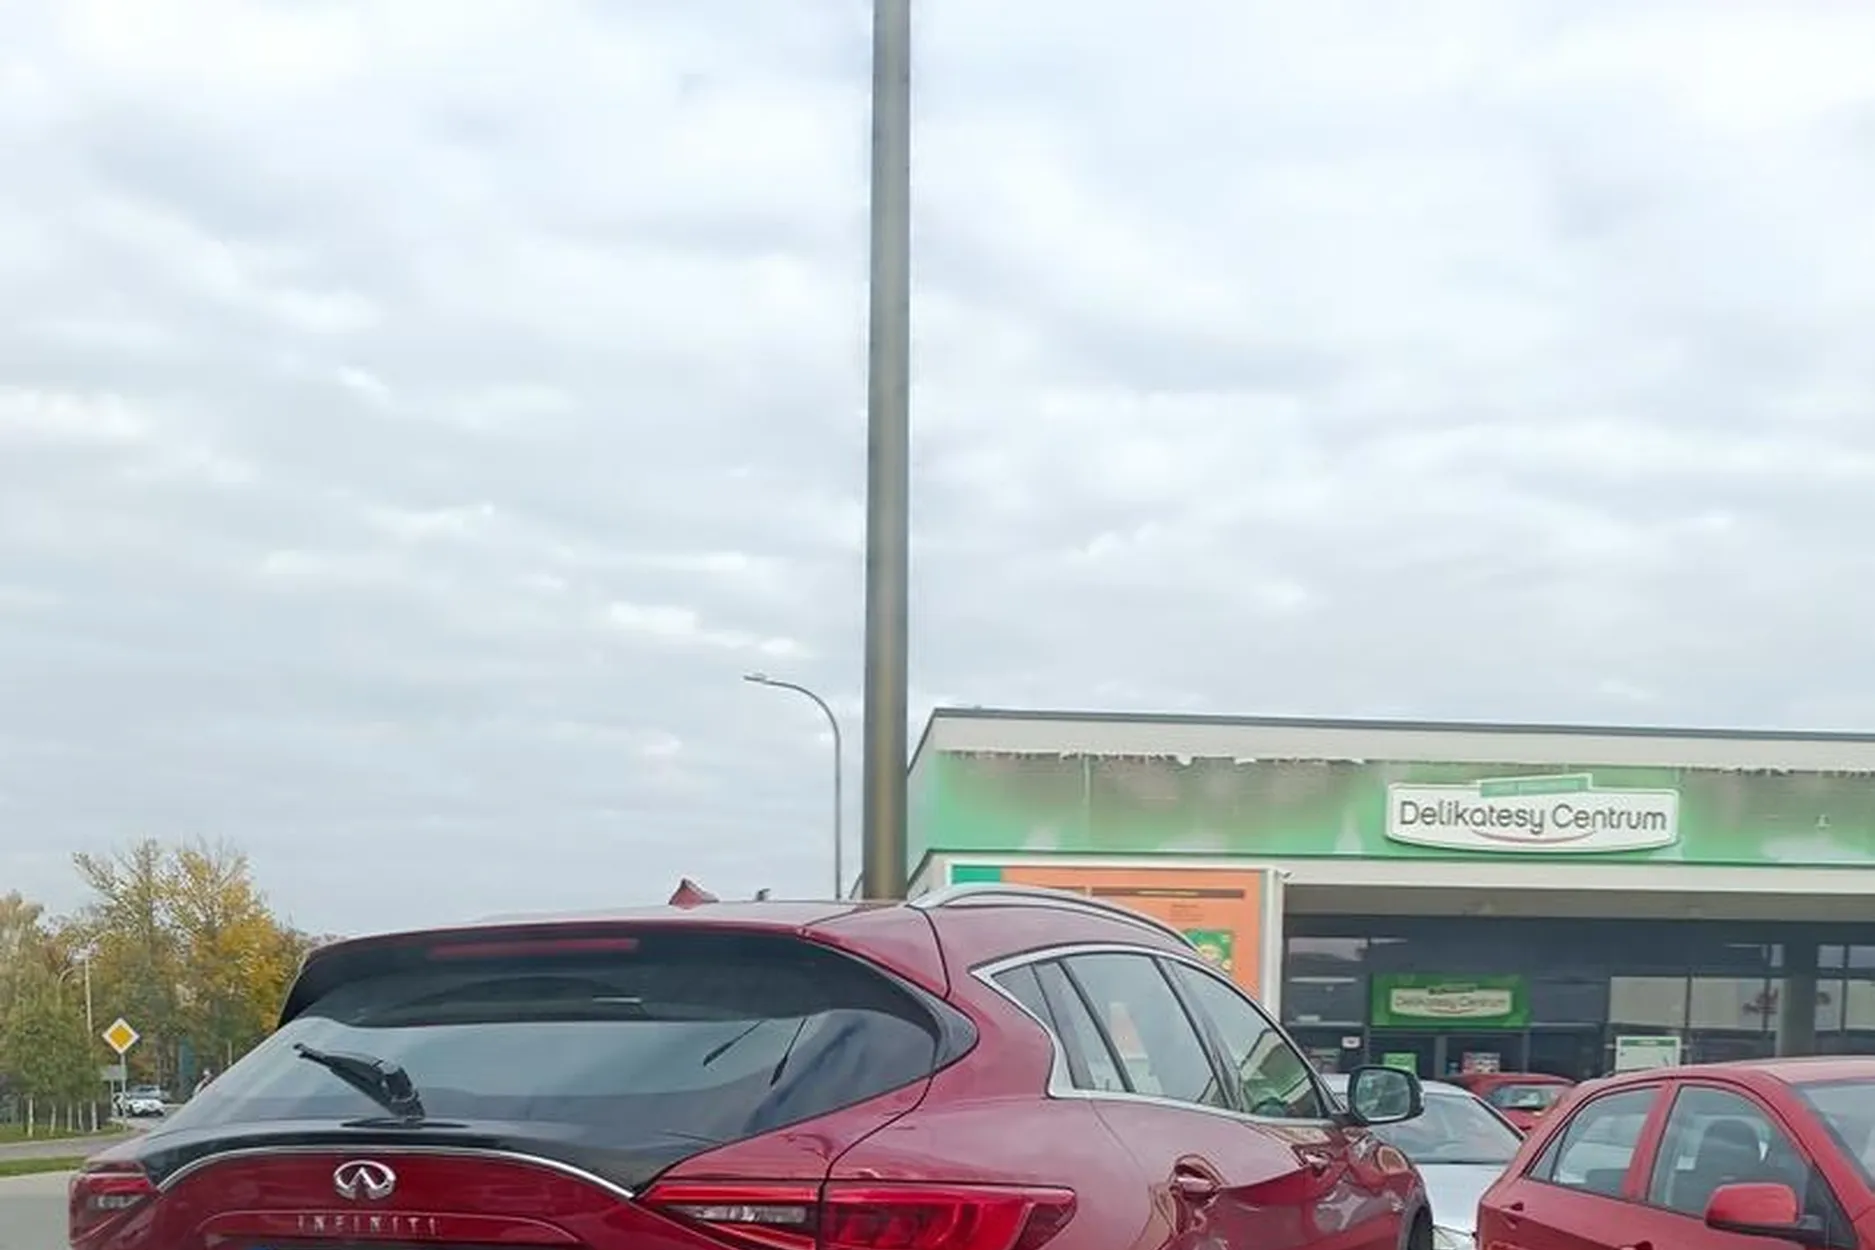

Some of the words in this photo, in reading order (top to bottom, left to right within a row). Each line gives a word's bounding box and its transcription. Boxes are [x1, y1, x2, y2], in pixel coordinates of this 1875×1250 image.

[1399, 800, 1544, 835] Delikatesy
[1551, 803, 1667, 831] Centrum
[298, 1215, 438, 1235] INFINITI
